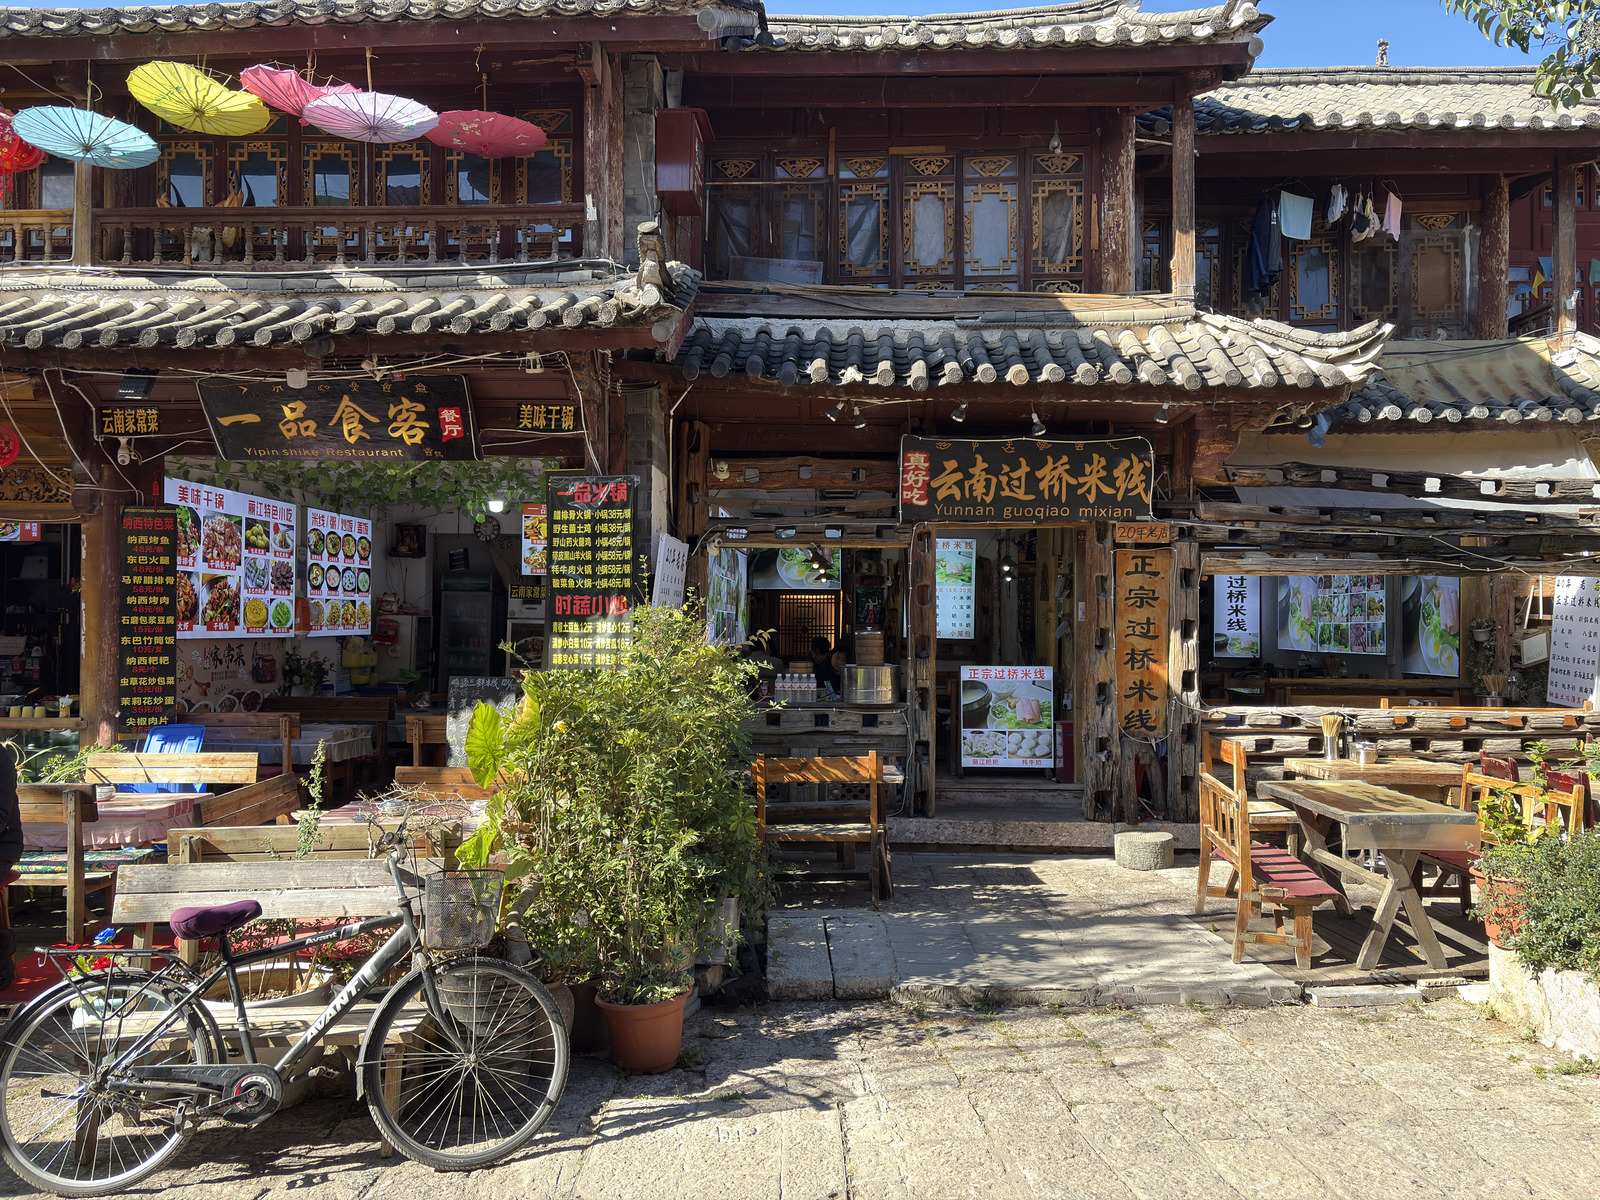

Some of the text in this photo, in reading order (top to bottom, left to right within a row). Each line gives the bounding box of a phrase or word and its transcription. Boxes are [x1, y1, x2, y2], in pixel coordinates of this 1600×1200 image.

[102, 408, 159, 434] 云南家常菜
[216, 394, 429, 447] 一品食客
[440, 409, 461, 437] 餐厅
[519, 404, 575, 430] 美味干锅
[244, 447, 404, 459] Yipin shike Restaurant
[902, 452, 929, 506] 真好吃
[930, 453, 1151, 505] 云南过桥米线
[178, 485, 225, 510] 美味干锅
[557, 483, 628, 503] 一品火锅
[248, 500, 293, 523] 丽江特色小吃
[934, 503, 1133, 519] Yunnan guoqiao mixian
[122, 517, 175, 531] 纳西特色菜
[127, 535, 170, 545] 纳西烤鱼
[1118, 526, 1169, 541] 20年老店
[936, 541, 974, 550] 桥米线
[127, 555, 170, 565] 东巴火腿
[127, 596, 170, 605] 纳西烤肉
[555, 595, 628, 616] 时蔬小炒
[1227, 576, 1248, 632] 过桥米线
[121, 636, 175, 646] 东巴竹筒饭
[1124, 555, 1161, 733] 正宗过桥米线
[126, 657, 170, 666] 纳西粑粑
[968, 668, 1046, 680] 正宗过桥米线
[120, 677, 175, 687] 虫草花炒包菜
[120, 697, 175, 706] 茉莉花炒蛋
[305, 932, 338, 946] Avant
